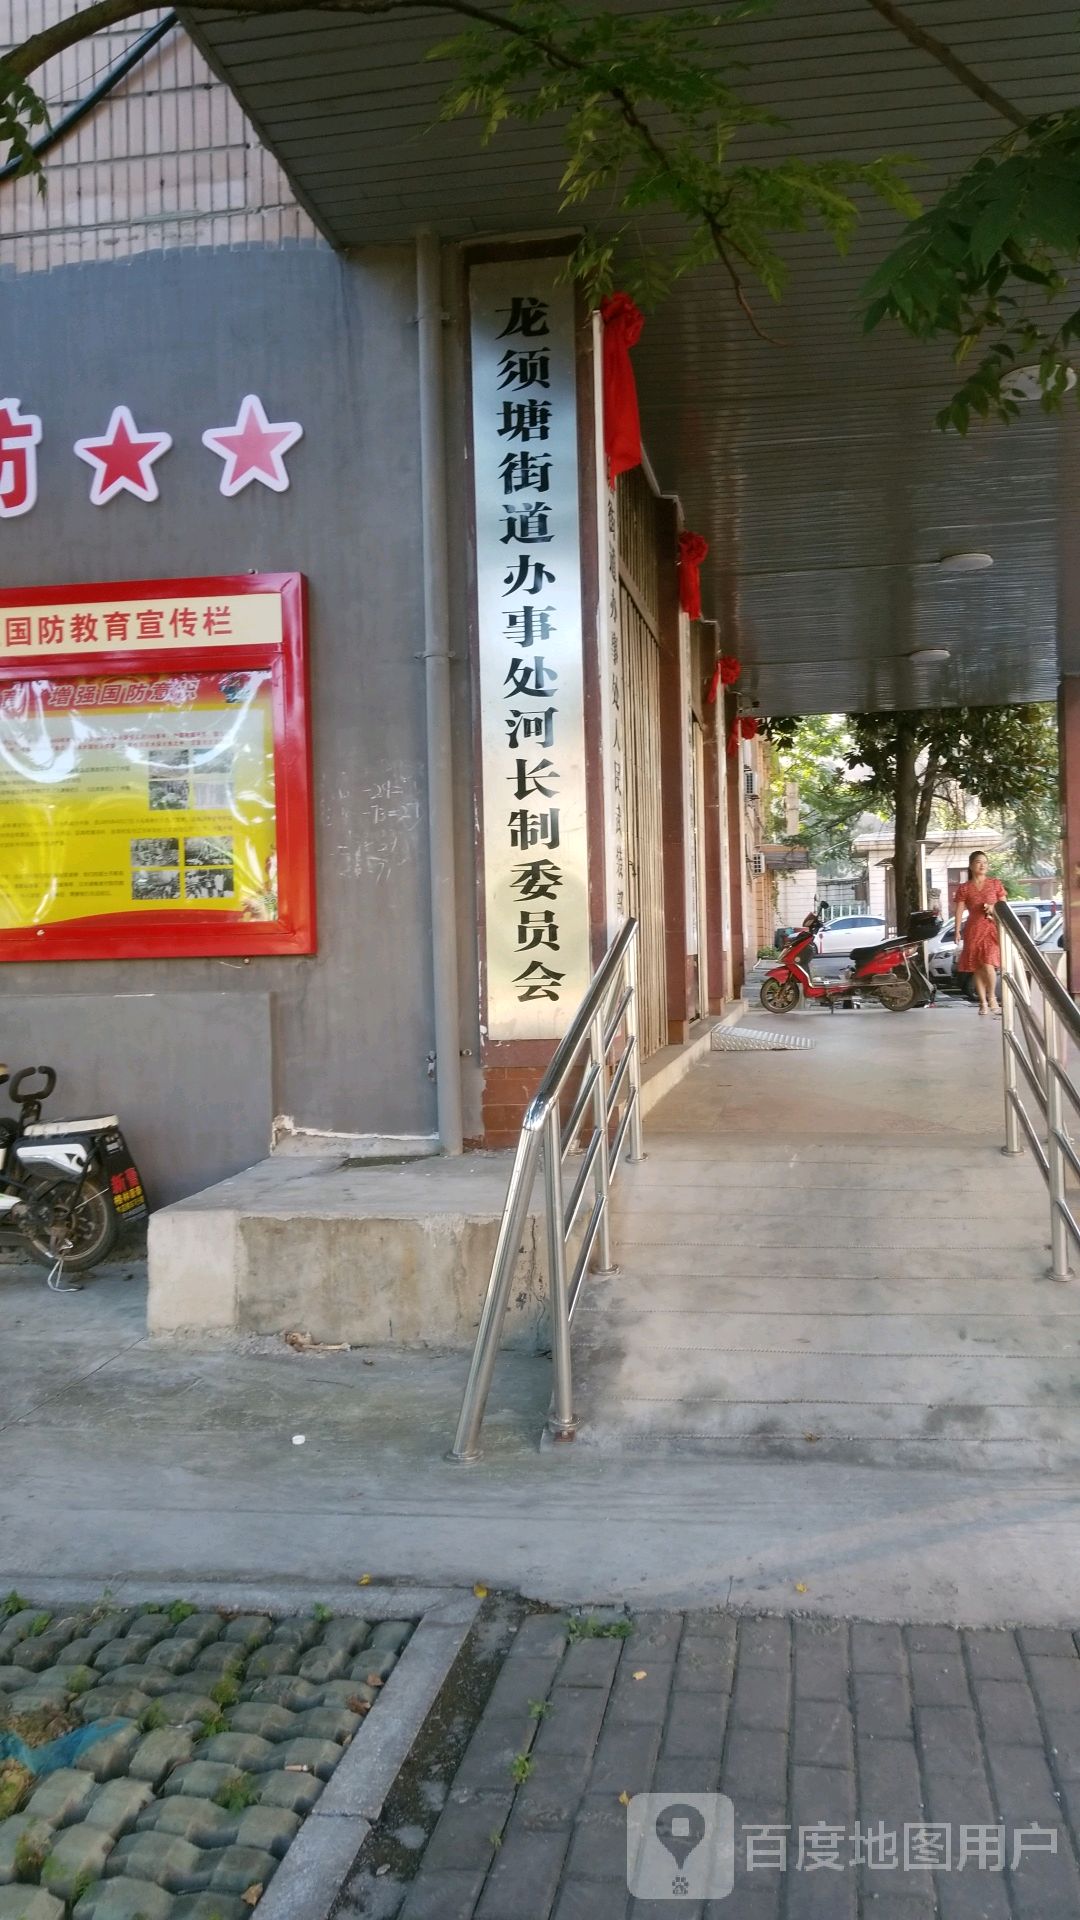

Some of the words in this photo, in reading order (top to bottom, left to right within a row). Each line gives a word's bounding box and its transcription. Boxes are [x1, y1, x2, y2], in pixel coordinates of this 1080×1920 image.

[5, 605, 233, 647] 国防教育宣传栏
[494, 296, 567, 1003] 龙须塘街道办事处河长制委员会
